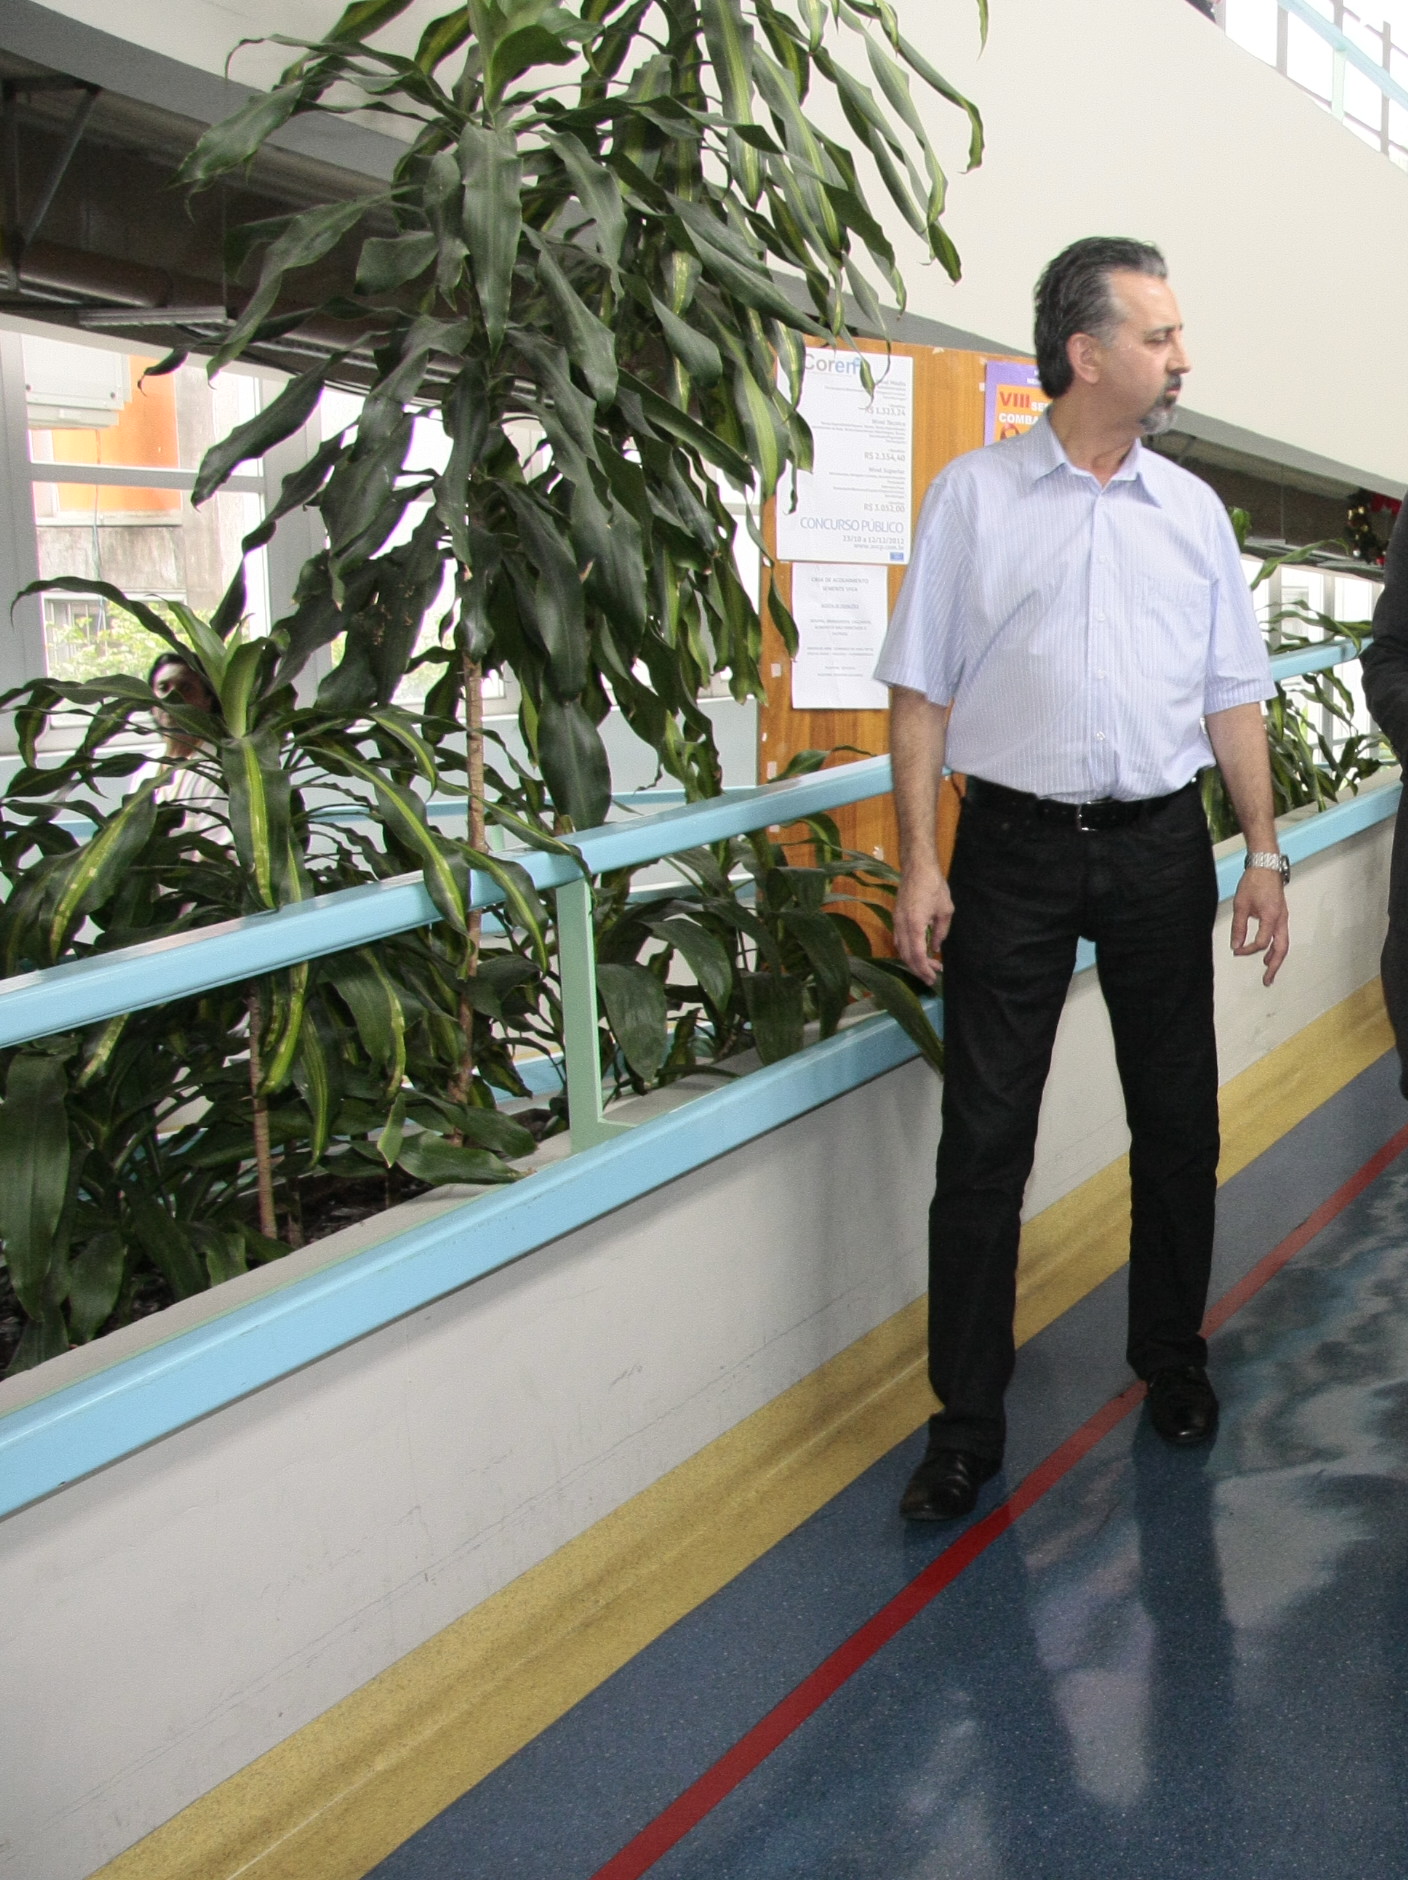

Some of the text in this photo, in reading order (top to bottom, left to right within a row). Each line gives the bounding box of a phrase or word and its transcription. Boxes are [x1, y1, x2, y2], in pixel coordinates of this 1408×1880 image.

[1000, 391, 1030, 408] VIII
[800, 516, 905, 534] CONCURSO PÚBLICO
